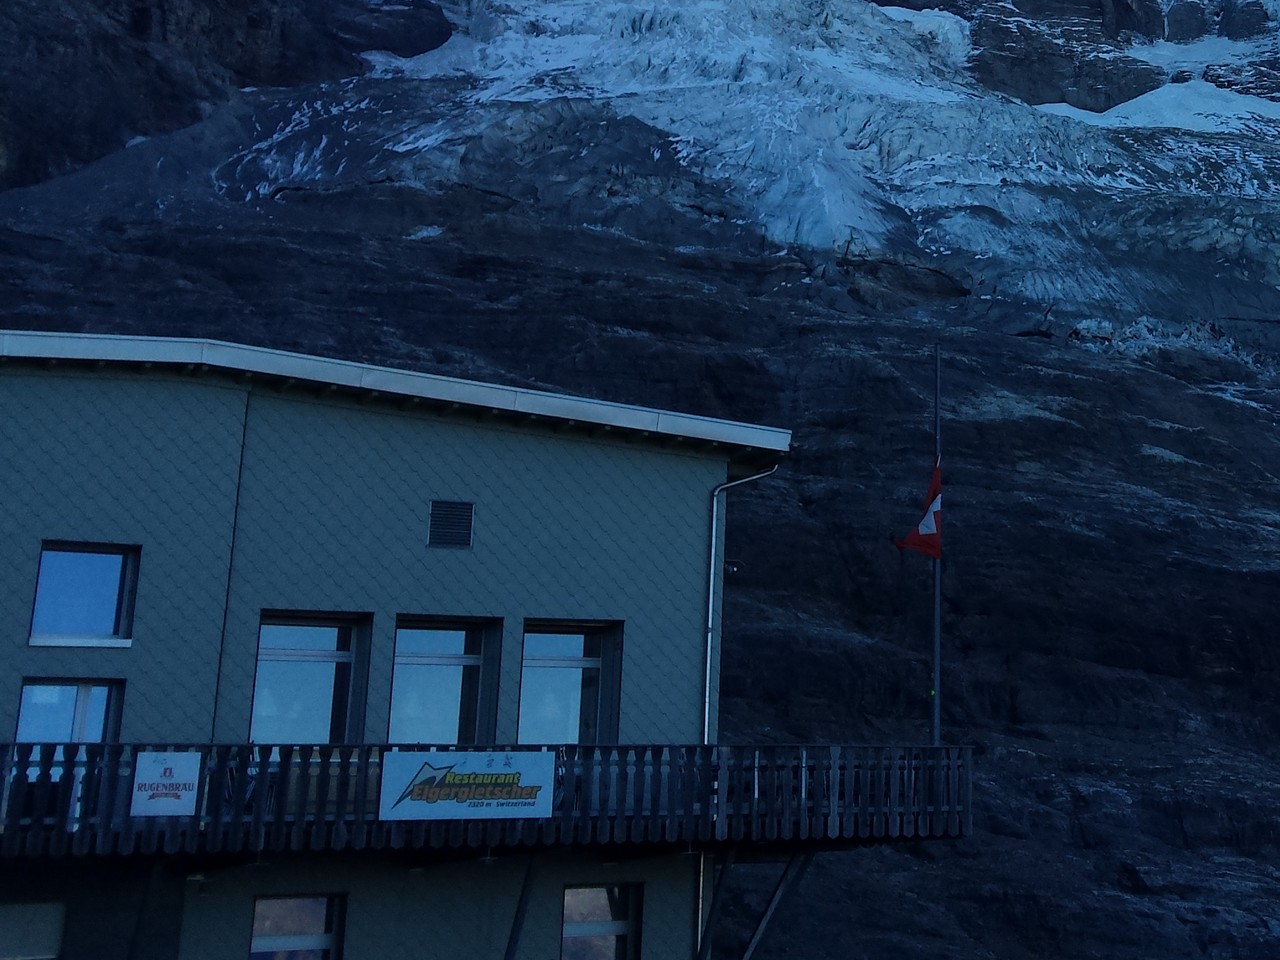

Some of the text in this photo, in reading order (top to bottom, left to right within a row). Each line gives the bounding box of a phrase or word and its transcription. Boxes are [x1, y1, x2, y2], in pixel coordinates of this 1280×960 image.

[445, 771, 522, 783] Restaurant
[409, 783, 542, 803] Eigergletscher
[496, 800, 536, 808] Switzerland
